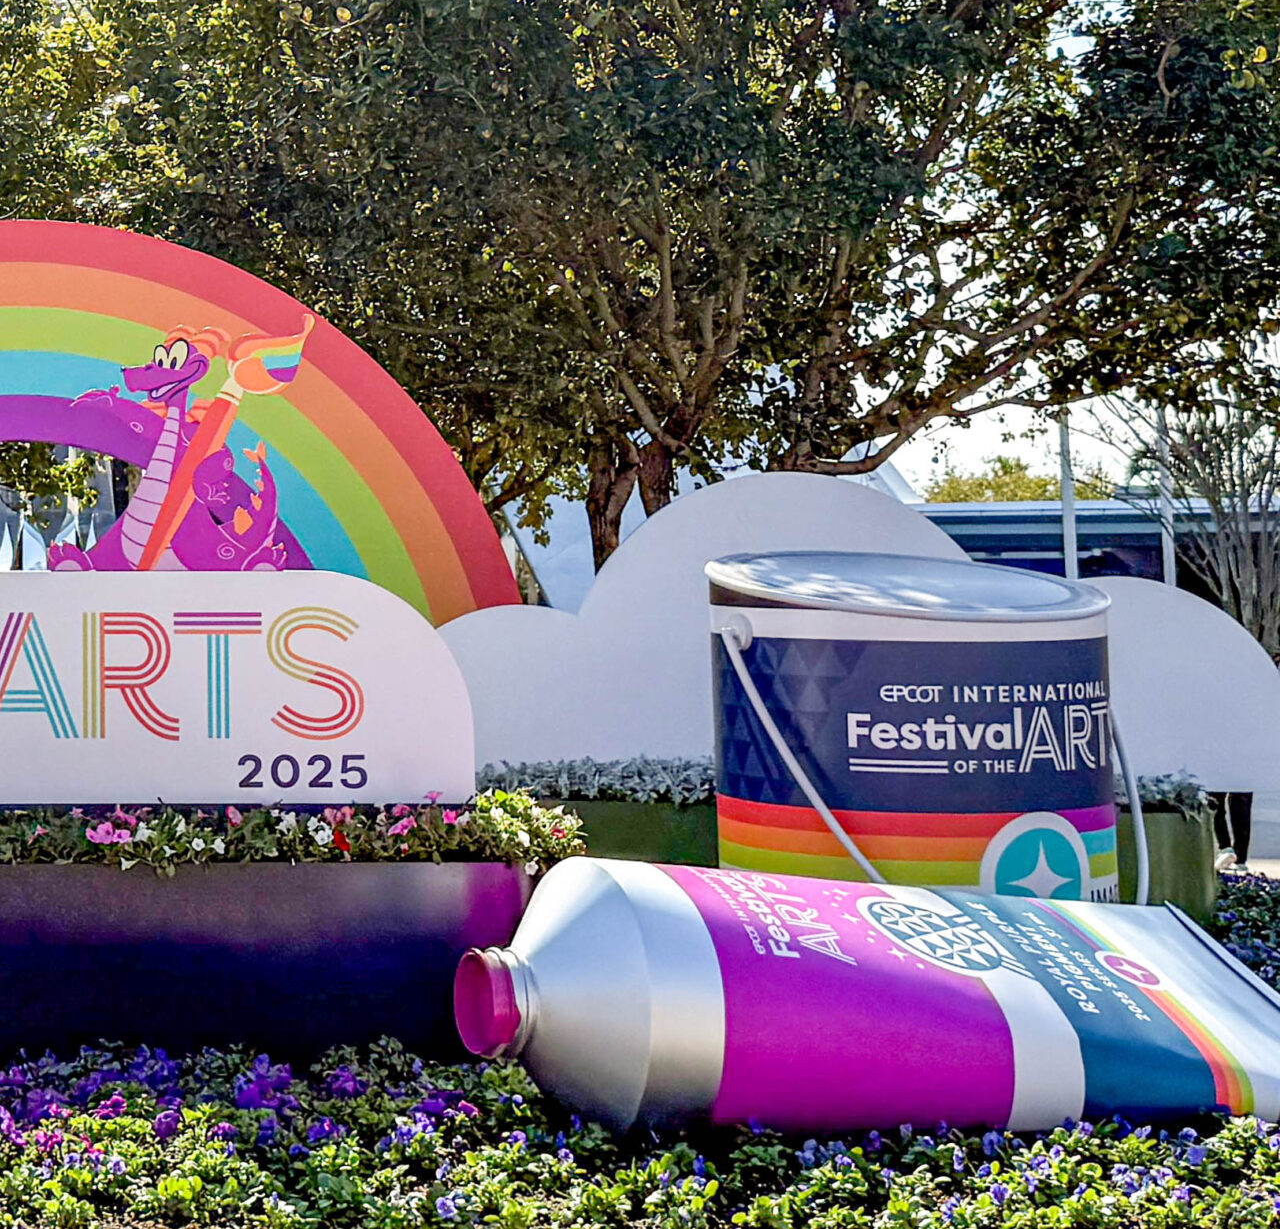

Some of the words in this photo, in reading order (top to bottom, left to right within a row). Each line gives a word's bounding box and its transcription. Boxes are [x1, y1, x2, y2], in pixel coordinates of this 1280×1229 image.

[880, 685, 943, 703] EPCOT
[953, 680, 1106, 703] INTERNATIONAL
[847, 707, 1023, 750] Festival
[1018, 701, 1109, 773] ART
[237, 754, 368, 789] 2025
[954, 759, 979, 773] OF
[982, 759, 1017, 773] THE
[729, 871, 858, 966] ARTS
[966, 901, 1042, 955] PURPLE
[1015, 923, 1103, 992] PIGMENT
[1038, 958, 1100, 1014] ROYAL
[1111, 989, 1152, 1022] 2025
